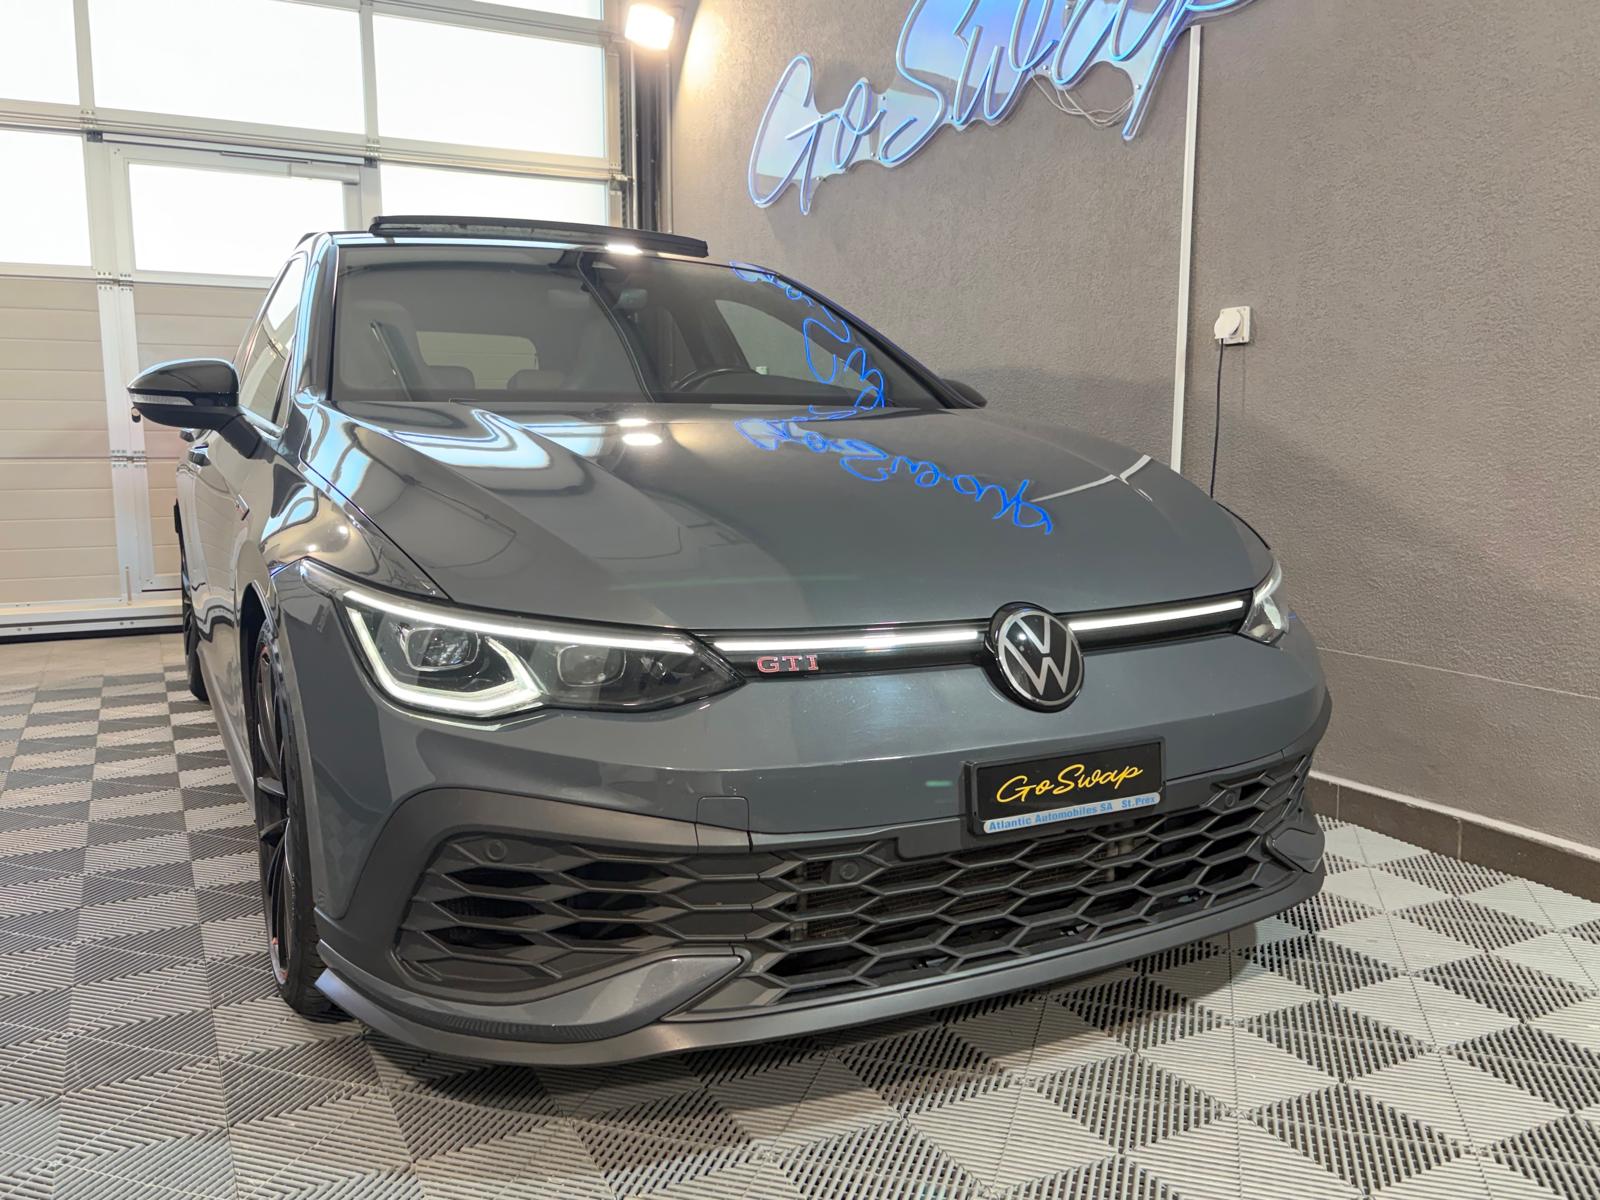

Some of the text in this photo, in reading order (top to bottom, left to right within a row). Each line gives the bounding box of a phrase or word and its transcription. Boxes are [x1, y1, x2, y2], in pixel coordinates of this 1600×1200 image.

[757, 654, 819, 674] GTI
[988, 814, 1033, 832] Atlantic
[1034, 805, 1098, 823] Automobiles
[1100, 801, 1113, 812] SA
